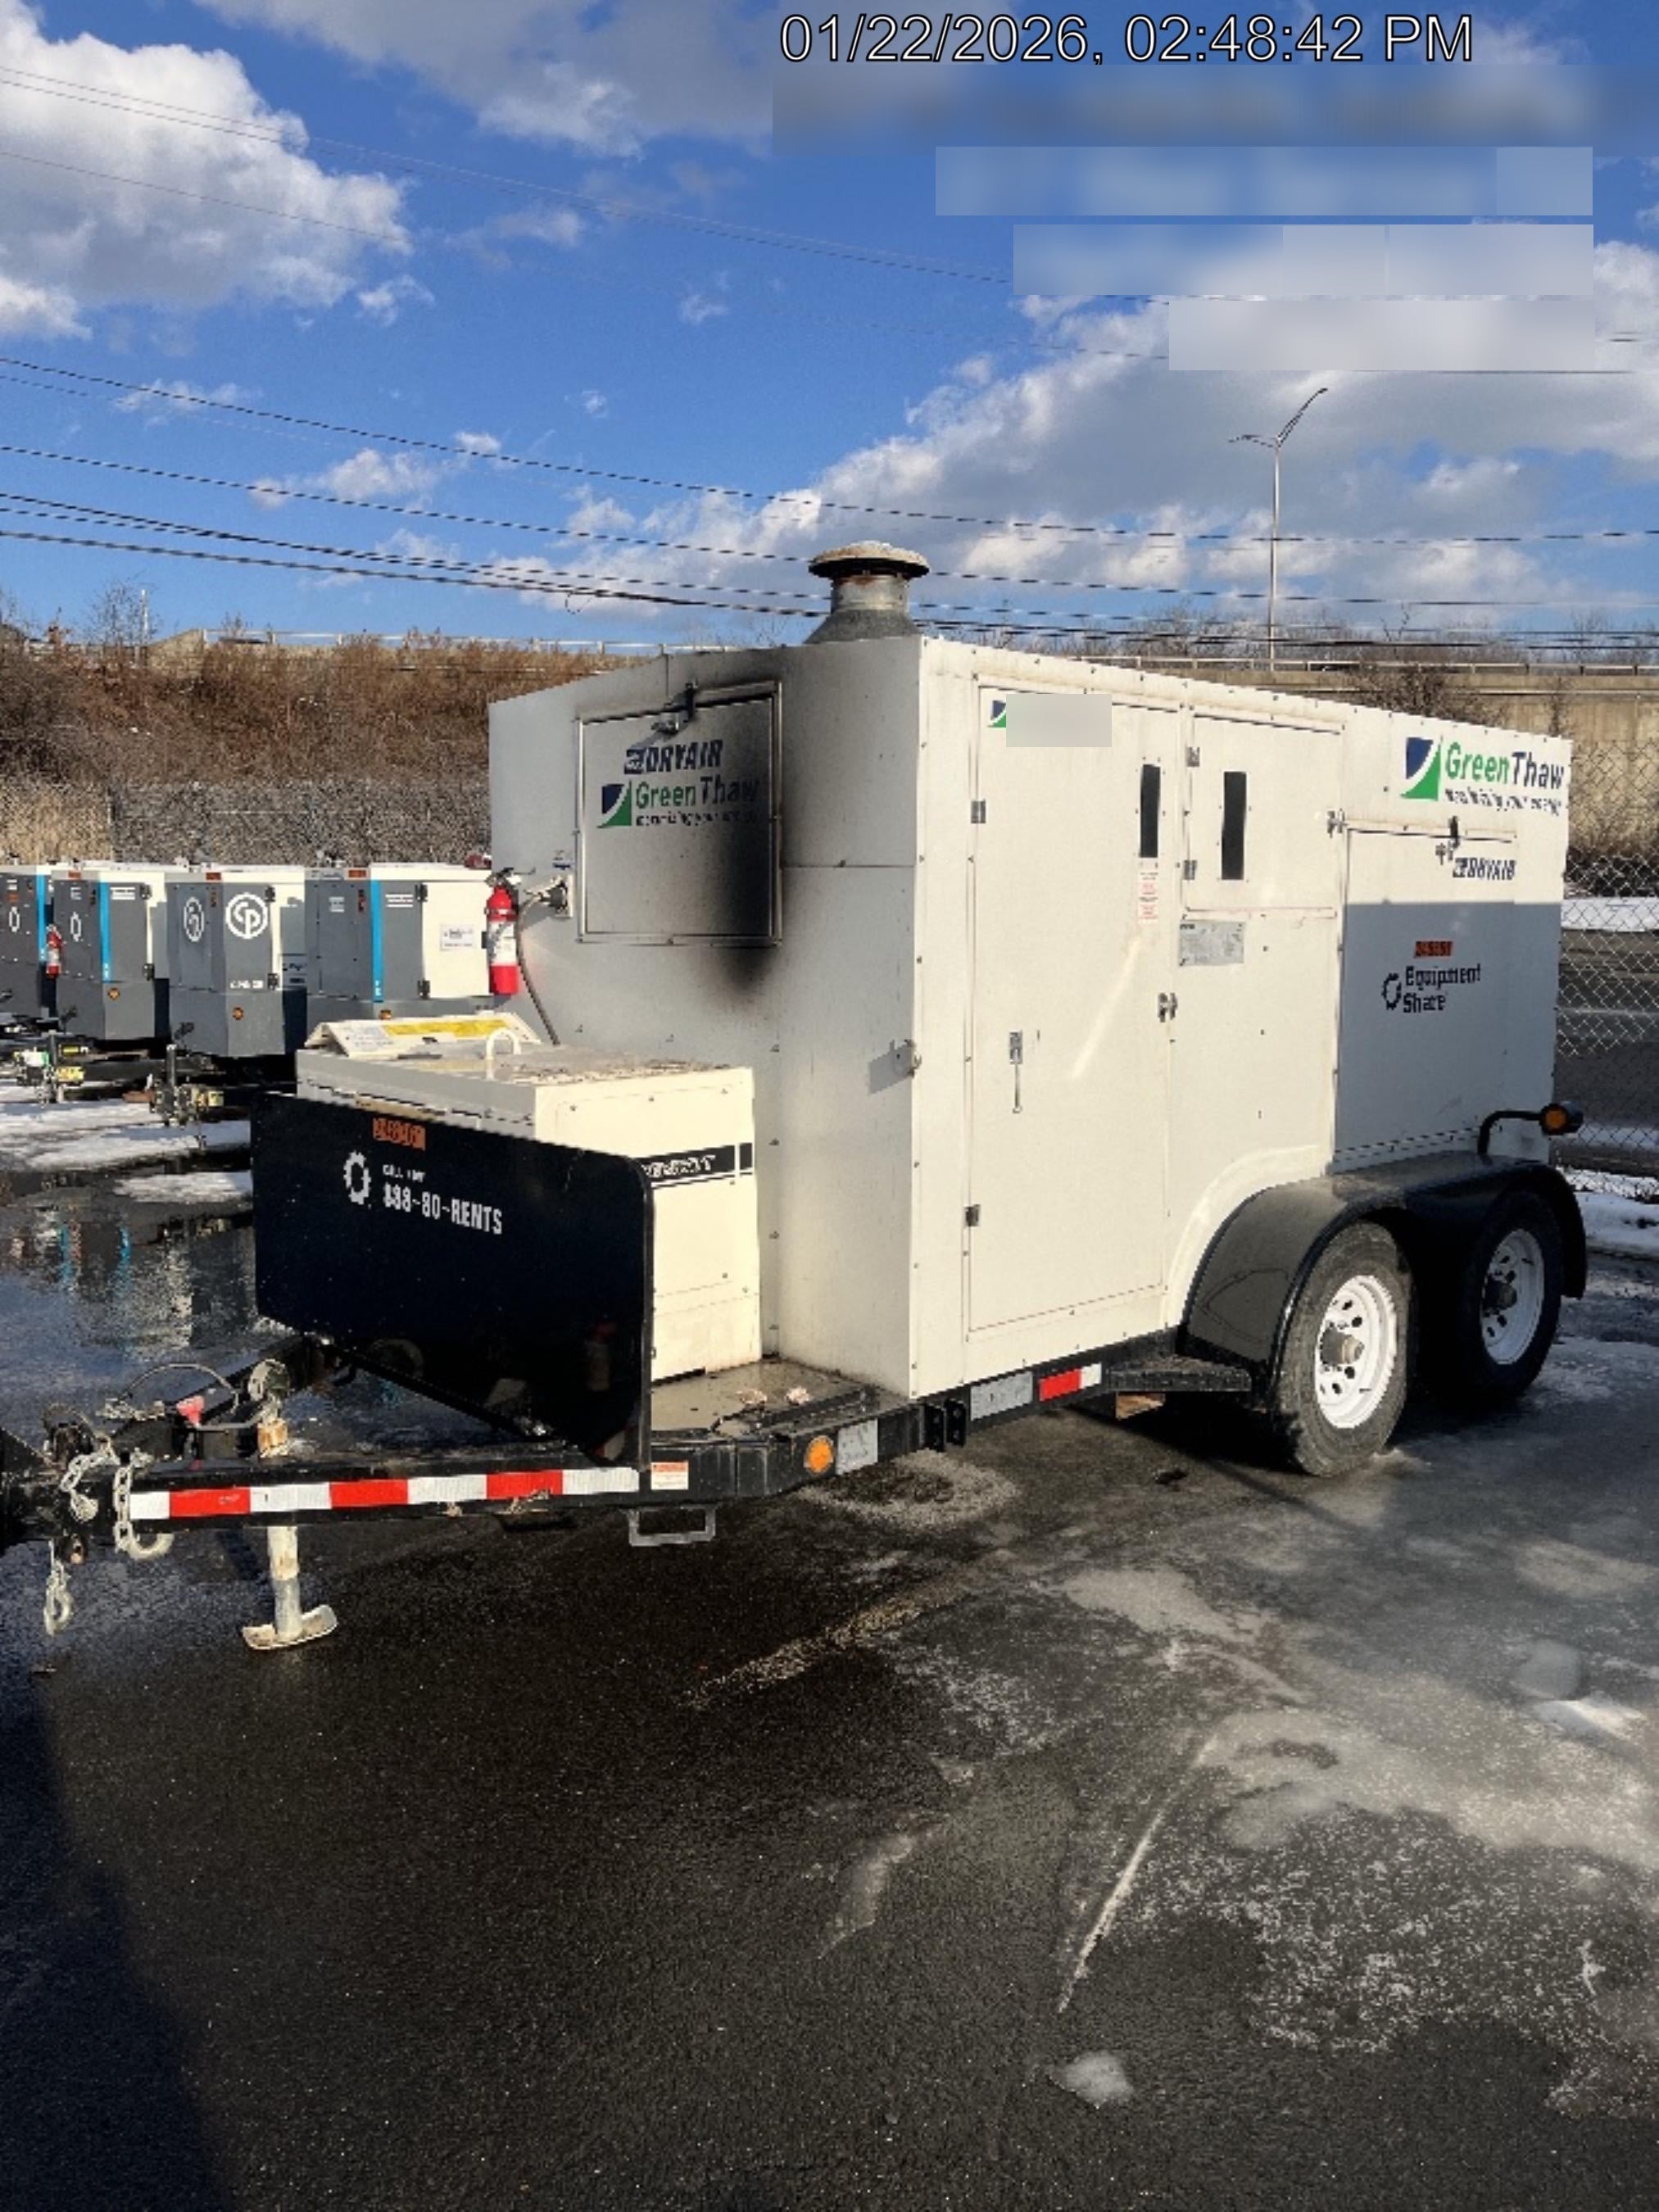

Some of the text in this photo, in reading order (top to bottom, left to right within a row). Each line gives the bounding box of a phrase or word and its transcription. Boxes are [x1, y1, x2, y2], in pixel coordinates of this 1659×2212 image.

[1445, 741, 1564, 790] GreenThaw
[636, 774, 760, 809] GreenThaw
[1405, 963, 1480, 990] Equipment
[1403, 992, 1446, 1013] Share
